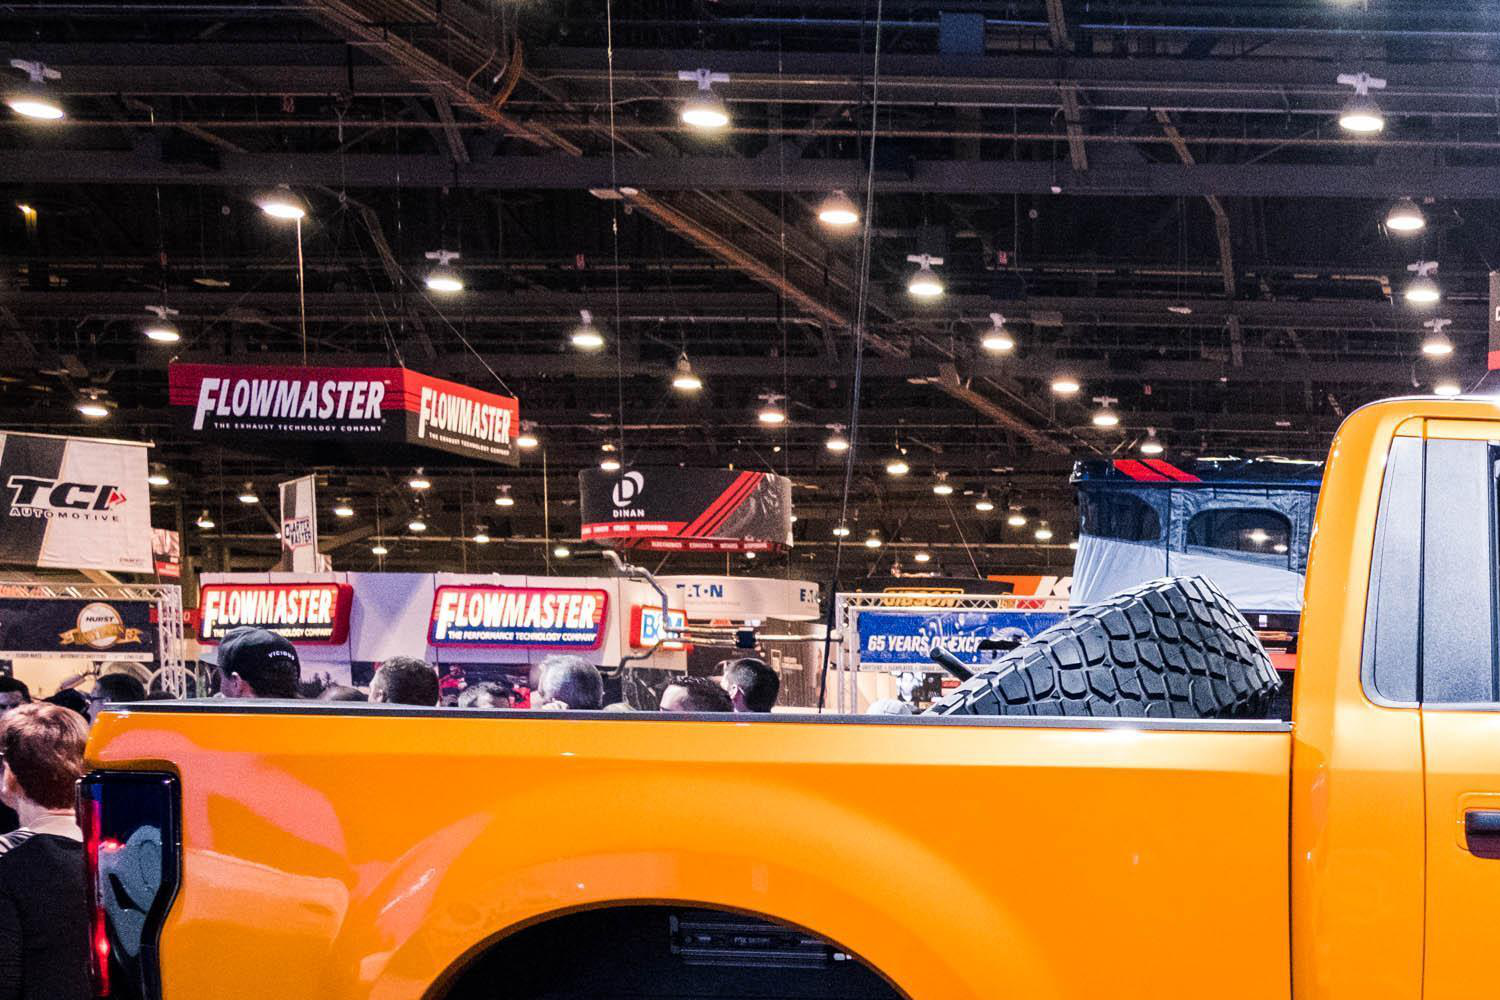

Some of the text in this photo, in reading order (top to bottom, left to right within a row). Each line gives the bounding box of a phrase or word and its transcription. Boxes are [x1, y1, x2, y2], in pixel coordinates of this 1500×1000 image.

[193, 377, 385, 430] FLOWMASTER
[418, 386, 511, 445] FLOWMASTER
[278, 424, 336, 432] TECHNOLOGY
[8, 475, 118, 511] TCI
[10, 508, 120, 522] AUTOMOTIVE
[612, 509, 645, 518] DINAN
[203, 590, 332, 639] FLOWMASTER
[435, 591, 597, 640] FLOWMASTER
[448, 630, 597, 642] THE PERFORMANCE TECHNOLOGY COMPANY
[868, 635, 885, 651] 65
[889, 636, 930, 652] YEARS
